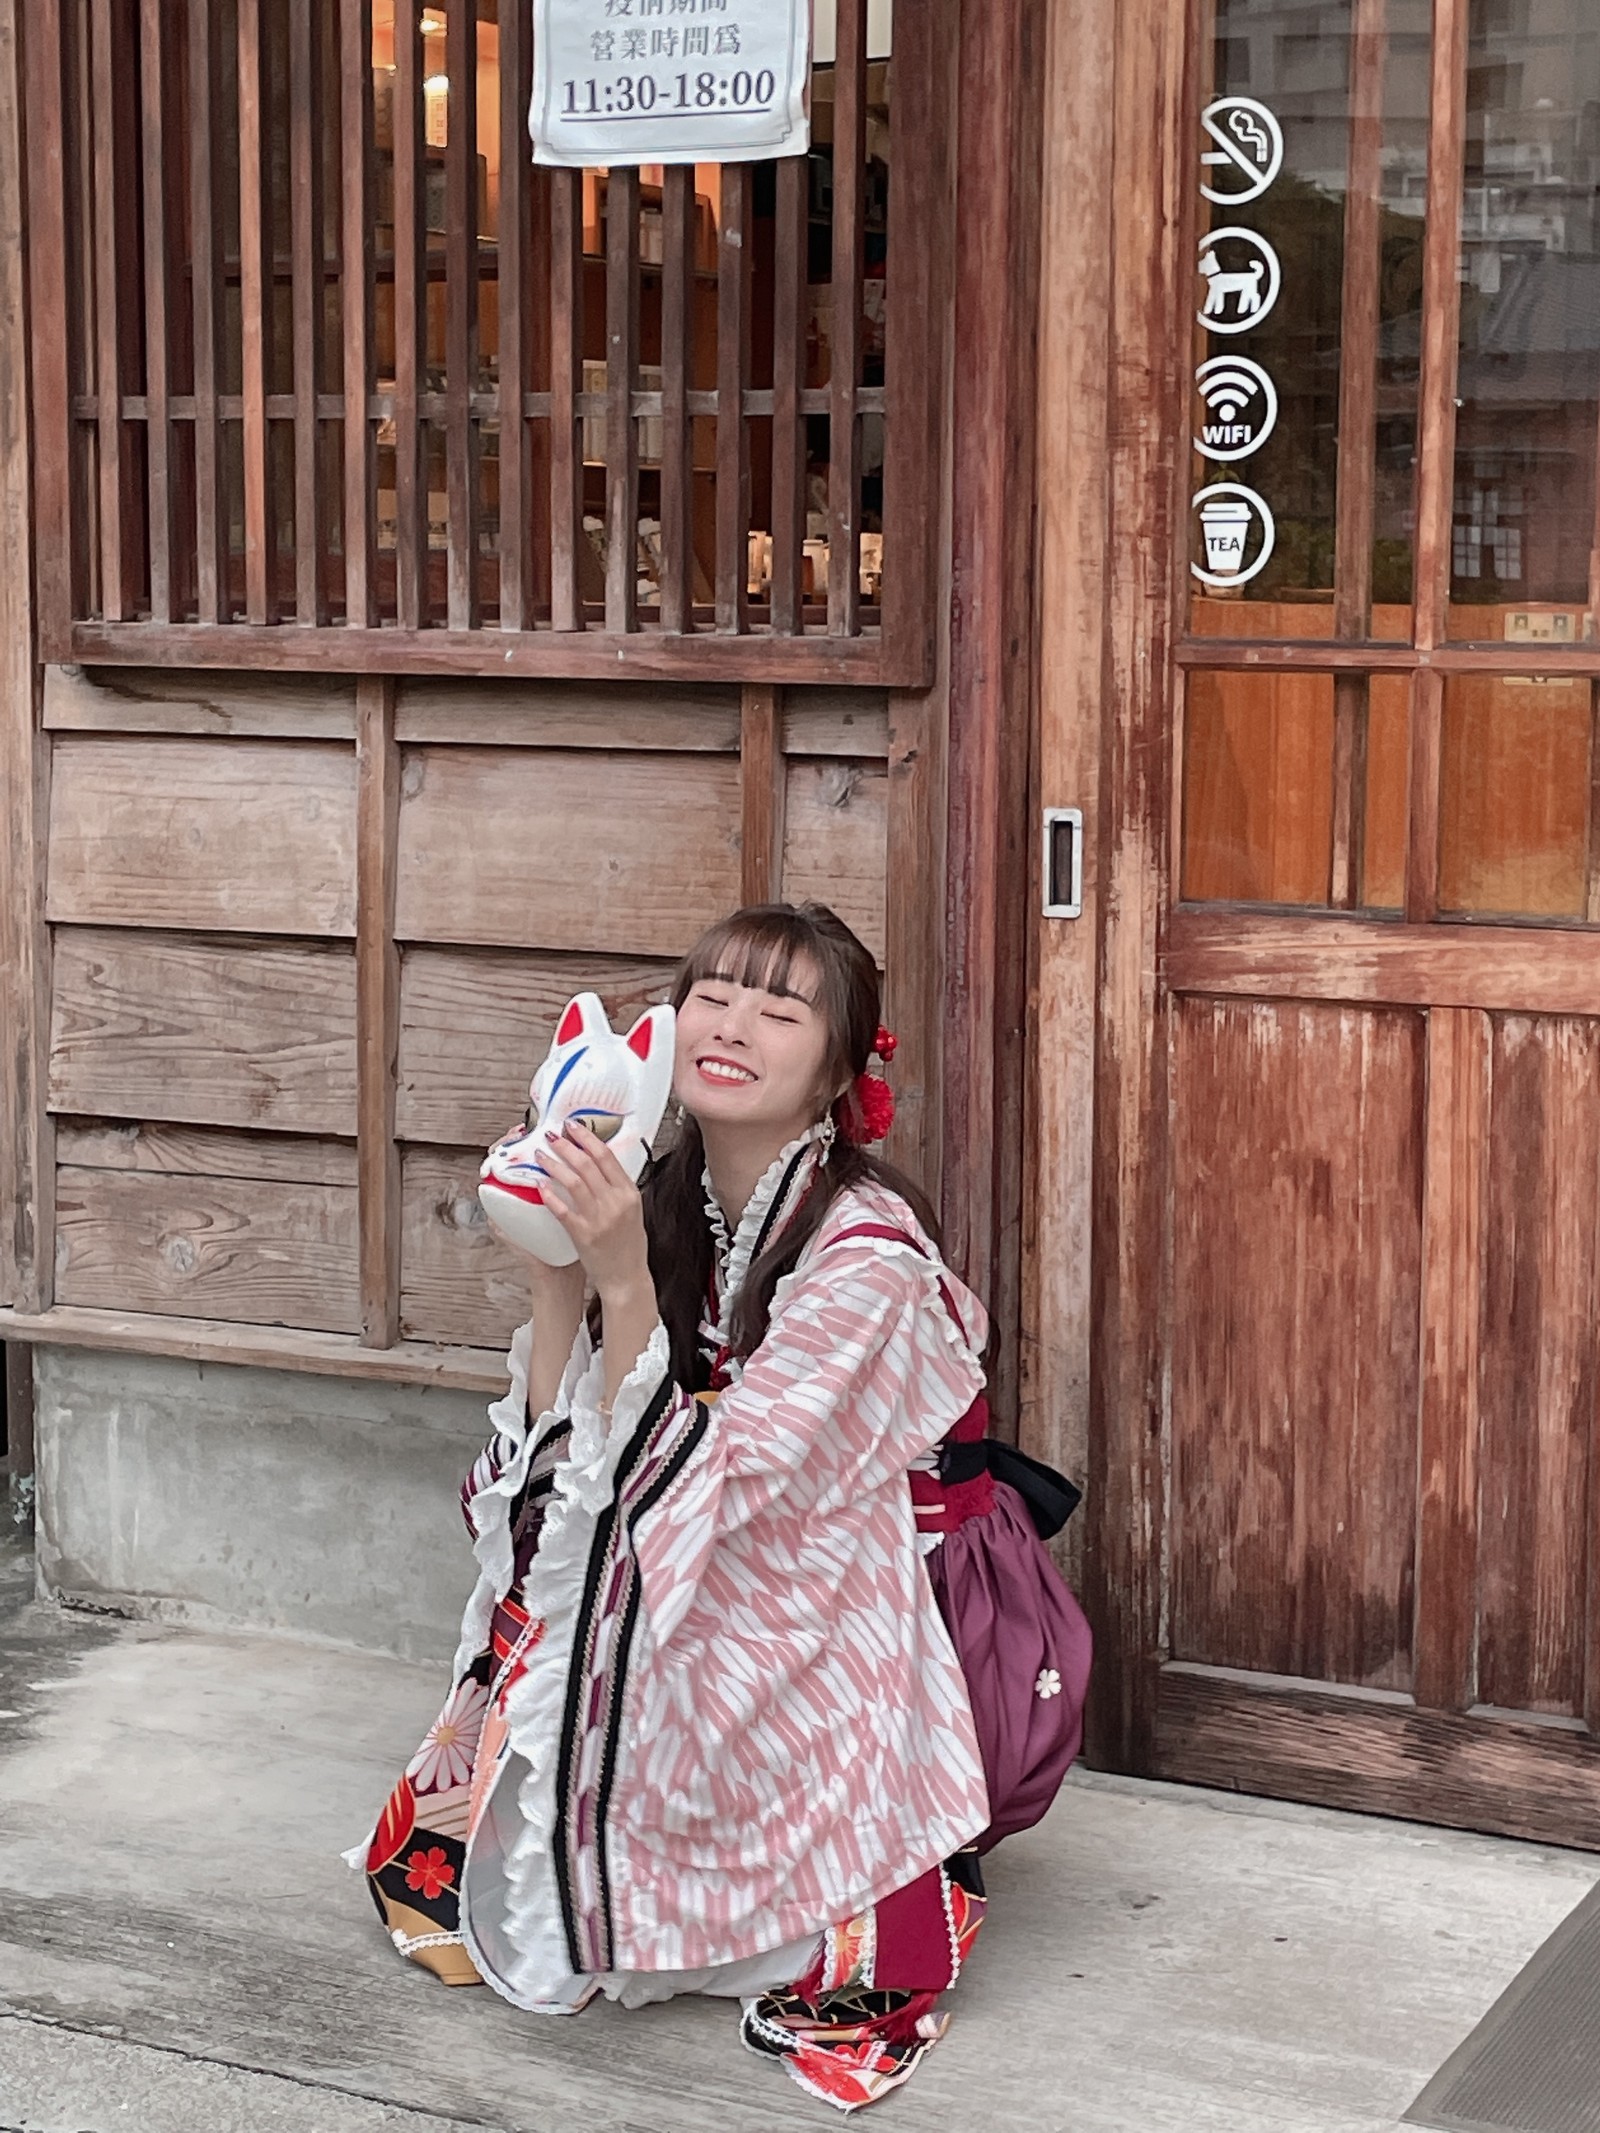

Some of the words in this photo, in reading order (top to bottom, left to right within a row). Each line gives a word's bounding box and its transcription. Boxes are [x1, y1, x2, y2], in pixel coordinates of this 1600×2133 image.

[560, 69, 775, 114] 11:30-18:00
[1202, 424, 1251, 444] WIFI
[1207, 536, 1240, 551] TEA
